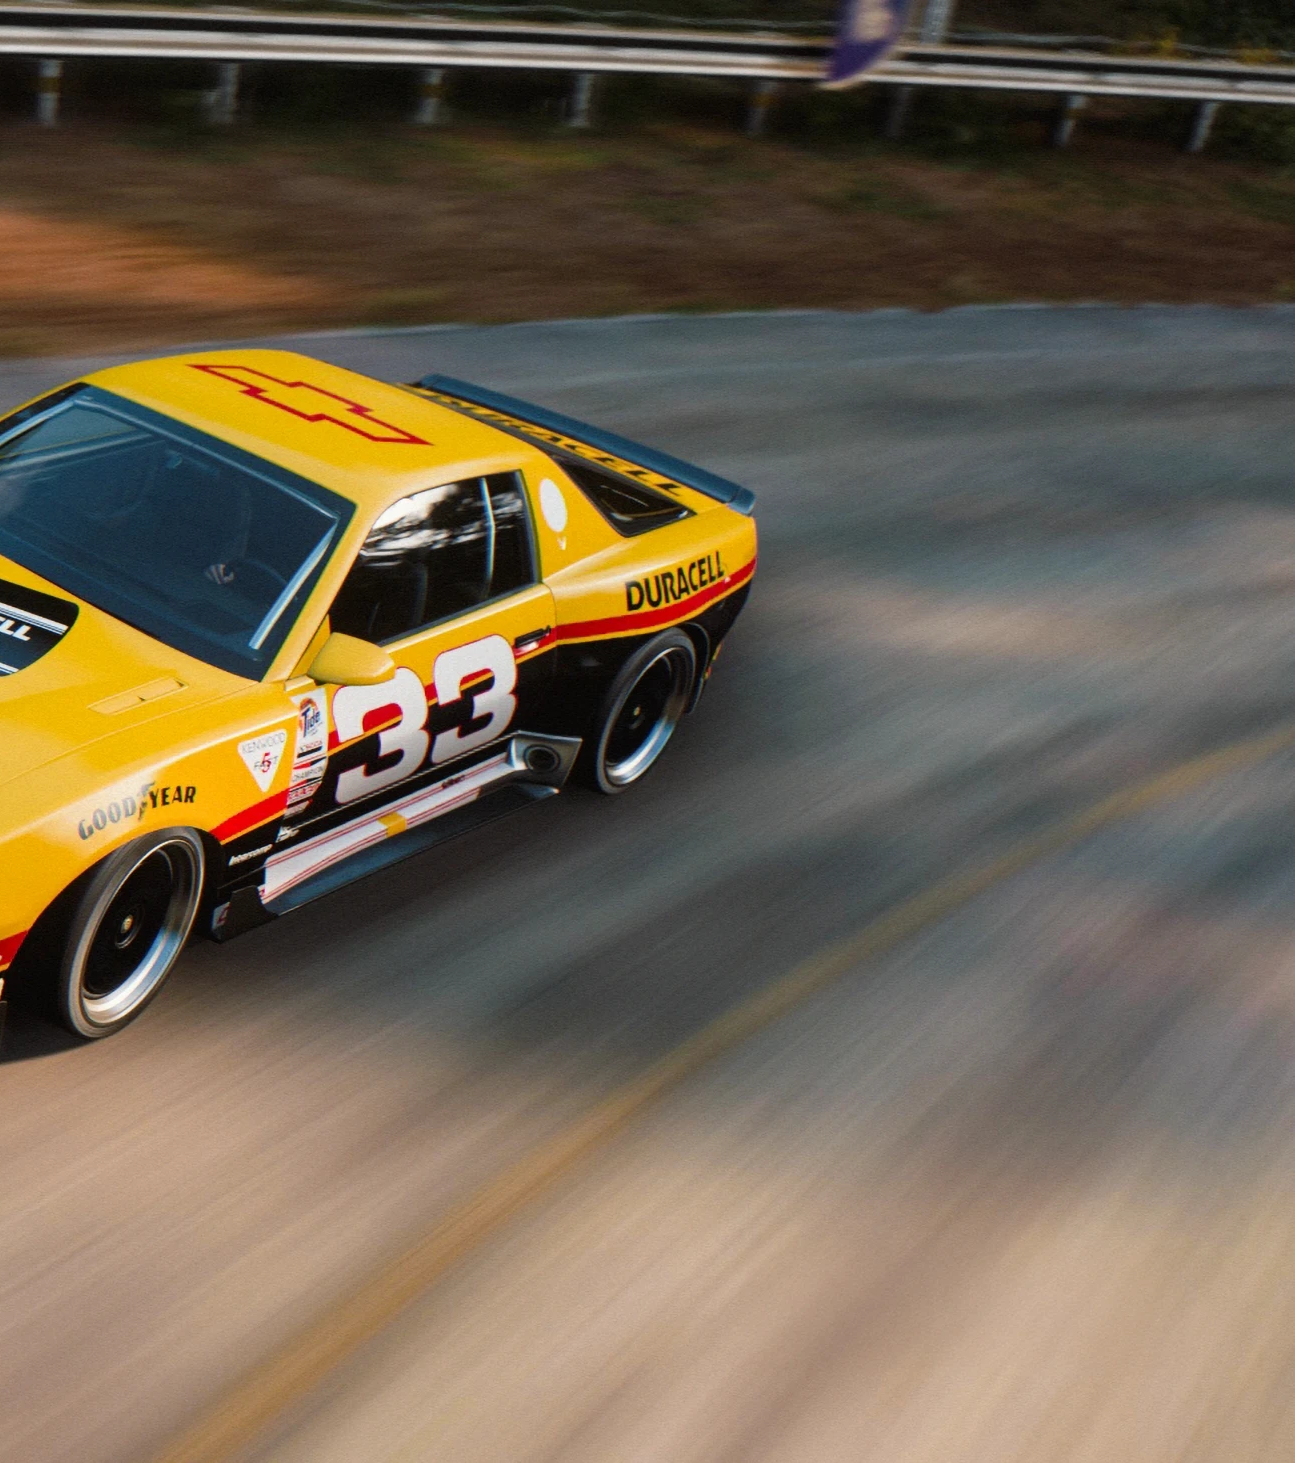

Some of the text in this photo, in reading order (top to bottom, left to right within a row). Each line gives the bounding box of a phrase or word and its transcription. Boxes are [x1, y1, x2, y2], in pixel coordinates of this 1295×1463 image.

[625, 550, 725, 612] DURACELL
[301, 706, 321, 738] Tide
[332, 633, 518, 804] 33
[241, 731, 286, 755] KENWOOD
